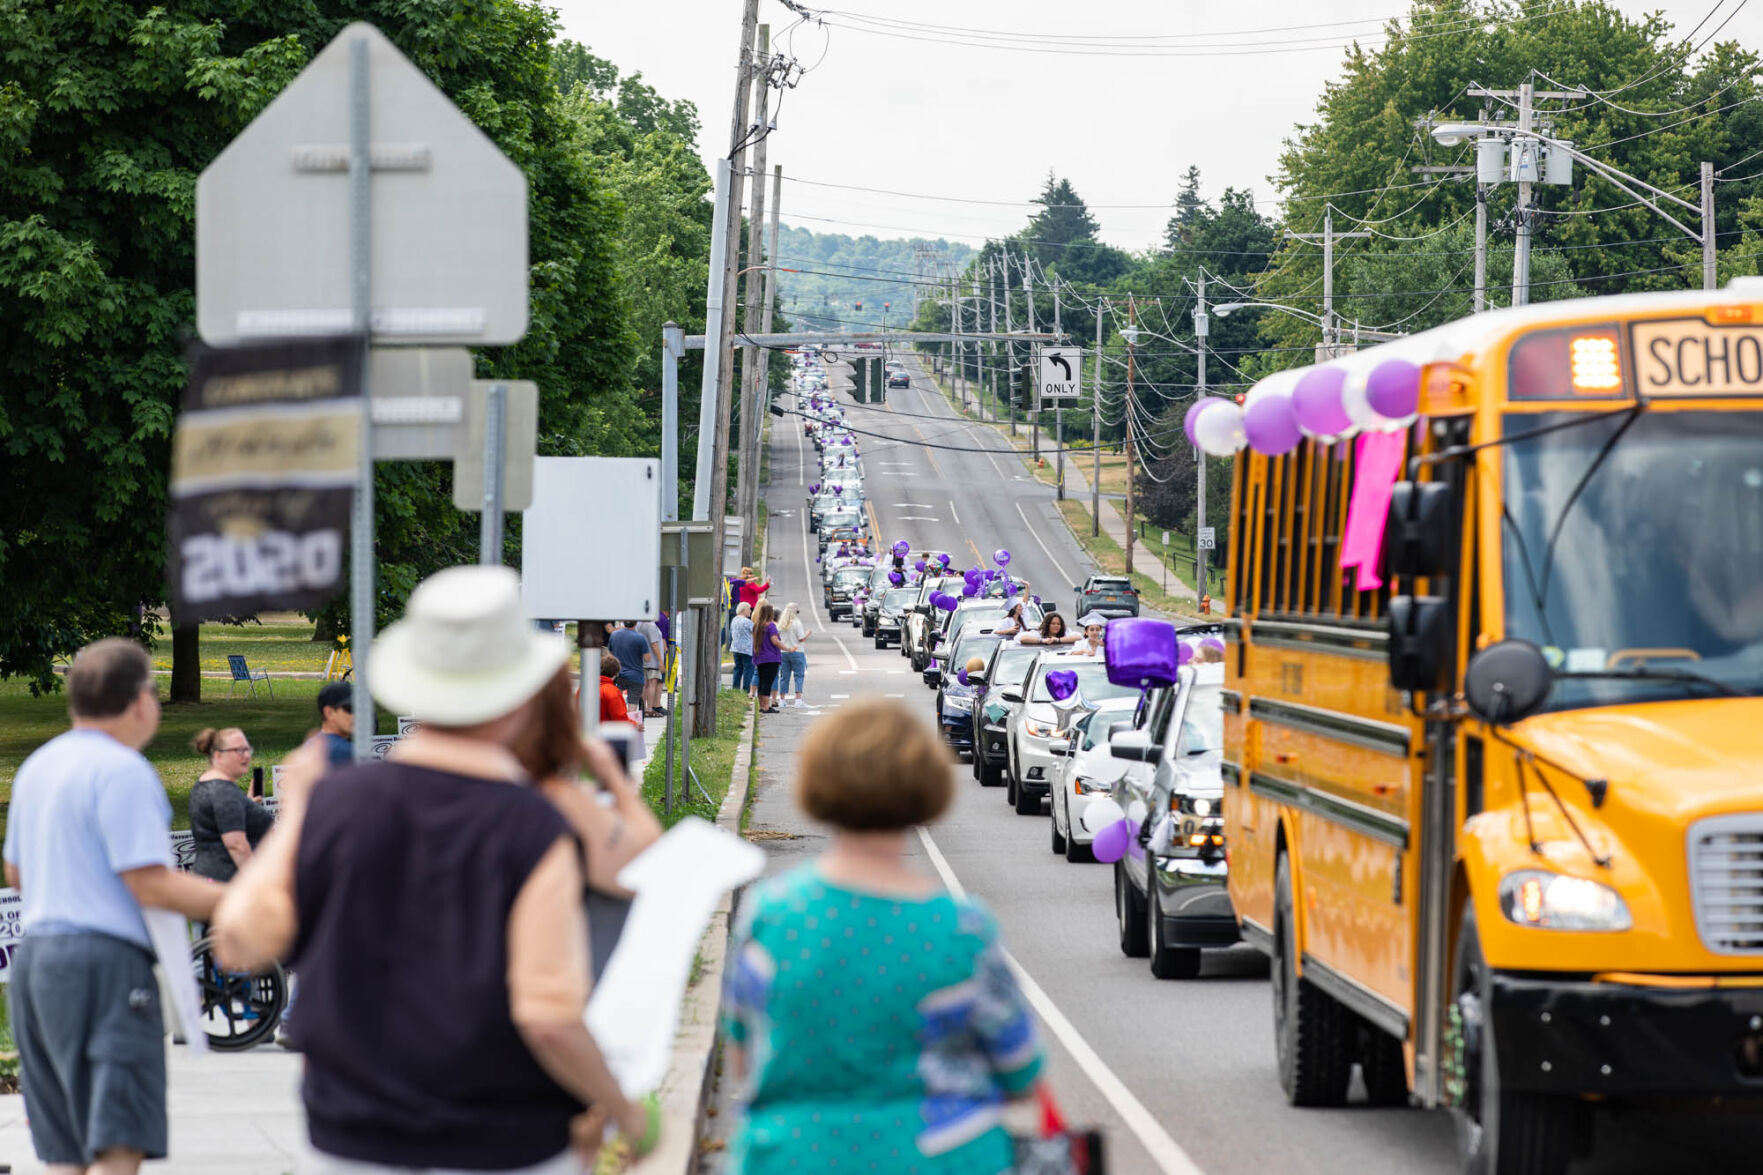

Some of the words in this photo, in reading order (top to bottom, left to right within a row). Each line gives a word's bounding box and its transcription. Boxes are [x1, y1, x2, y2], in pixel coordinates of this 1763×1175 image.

[1648, 335, 1762, 386] SCHO
[1046, 383, 1075, 393] ONLY
[1199, 539, 1214, 548] 30
[181, 529, 341, 602] 2020
